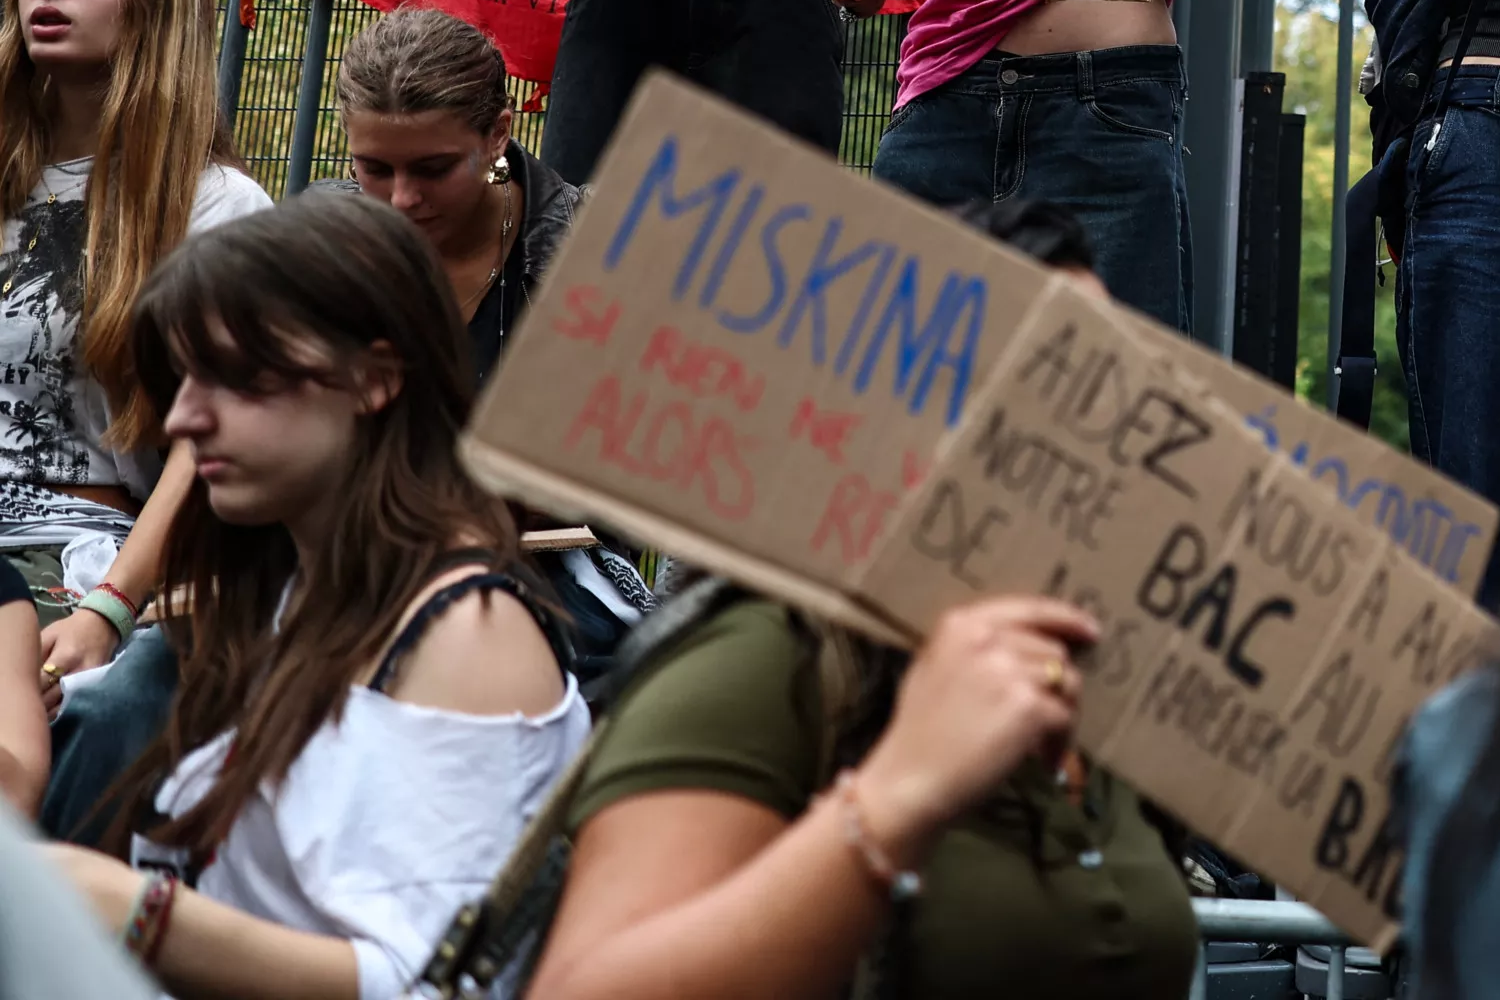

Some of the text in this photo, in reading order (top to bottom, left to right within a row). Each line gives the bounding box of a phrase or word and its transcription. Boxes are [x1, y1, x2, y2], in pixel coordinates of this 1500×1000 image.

[603, 135, 988, 428] MISKINA
[910, 477, 1011, 591] DE
[972, 404, 1124, 550] NOTRE
[1134, 522, 1296, 692] BAC
[1292, 650, 1383, 760] AU
[1016, 322, 1213, 500] AIDEZ
[1217, 467, 1356, 597] NOUS
